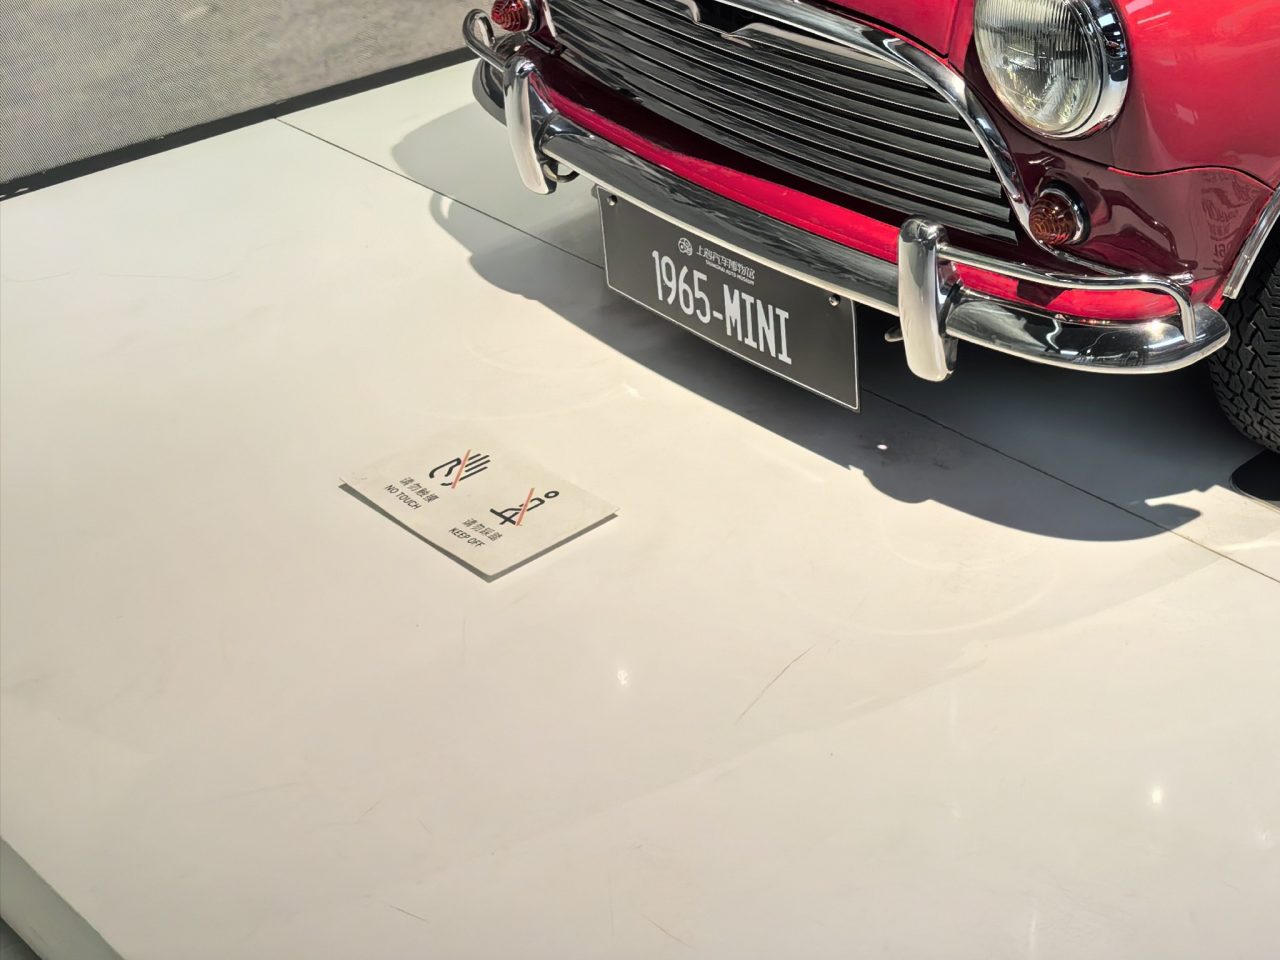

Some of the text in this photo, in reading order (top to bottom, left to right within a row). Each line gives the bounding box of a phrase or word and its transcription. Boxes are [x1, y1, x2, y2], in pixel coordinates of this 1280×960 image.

[652, 250, 792, 365] 1965-MINI
[385, 484, 422, 510] NO TOUCH
[448, 527, 485, 548] KEEP OFF
